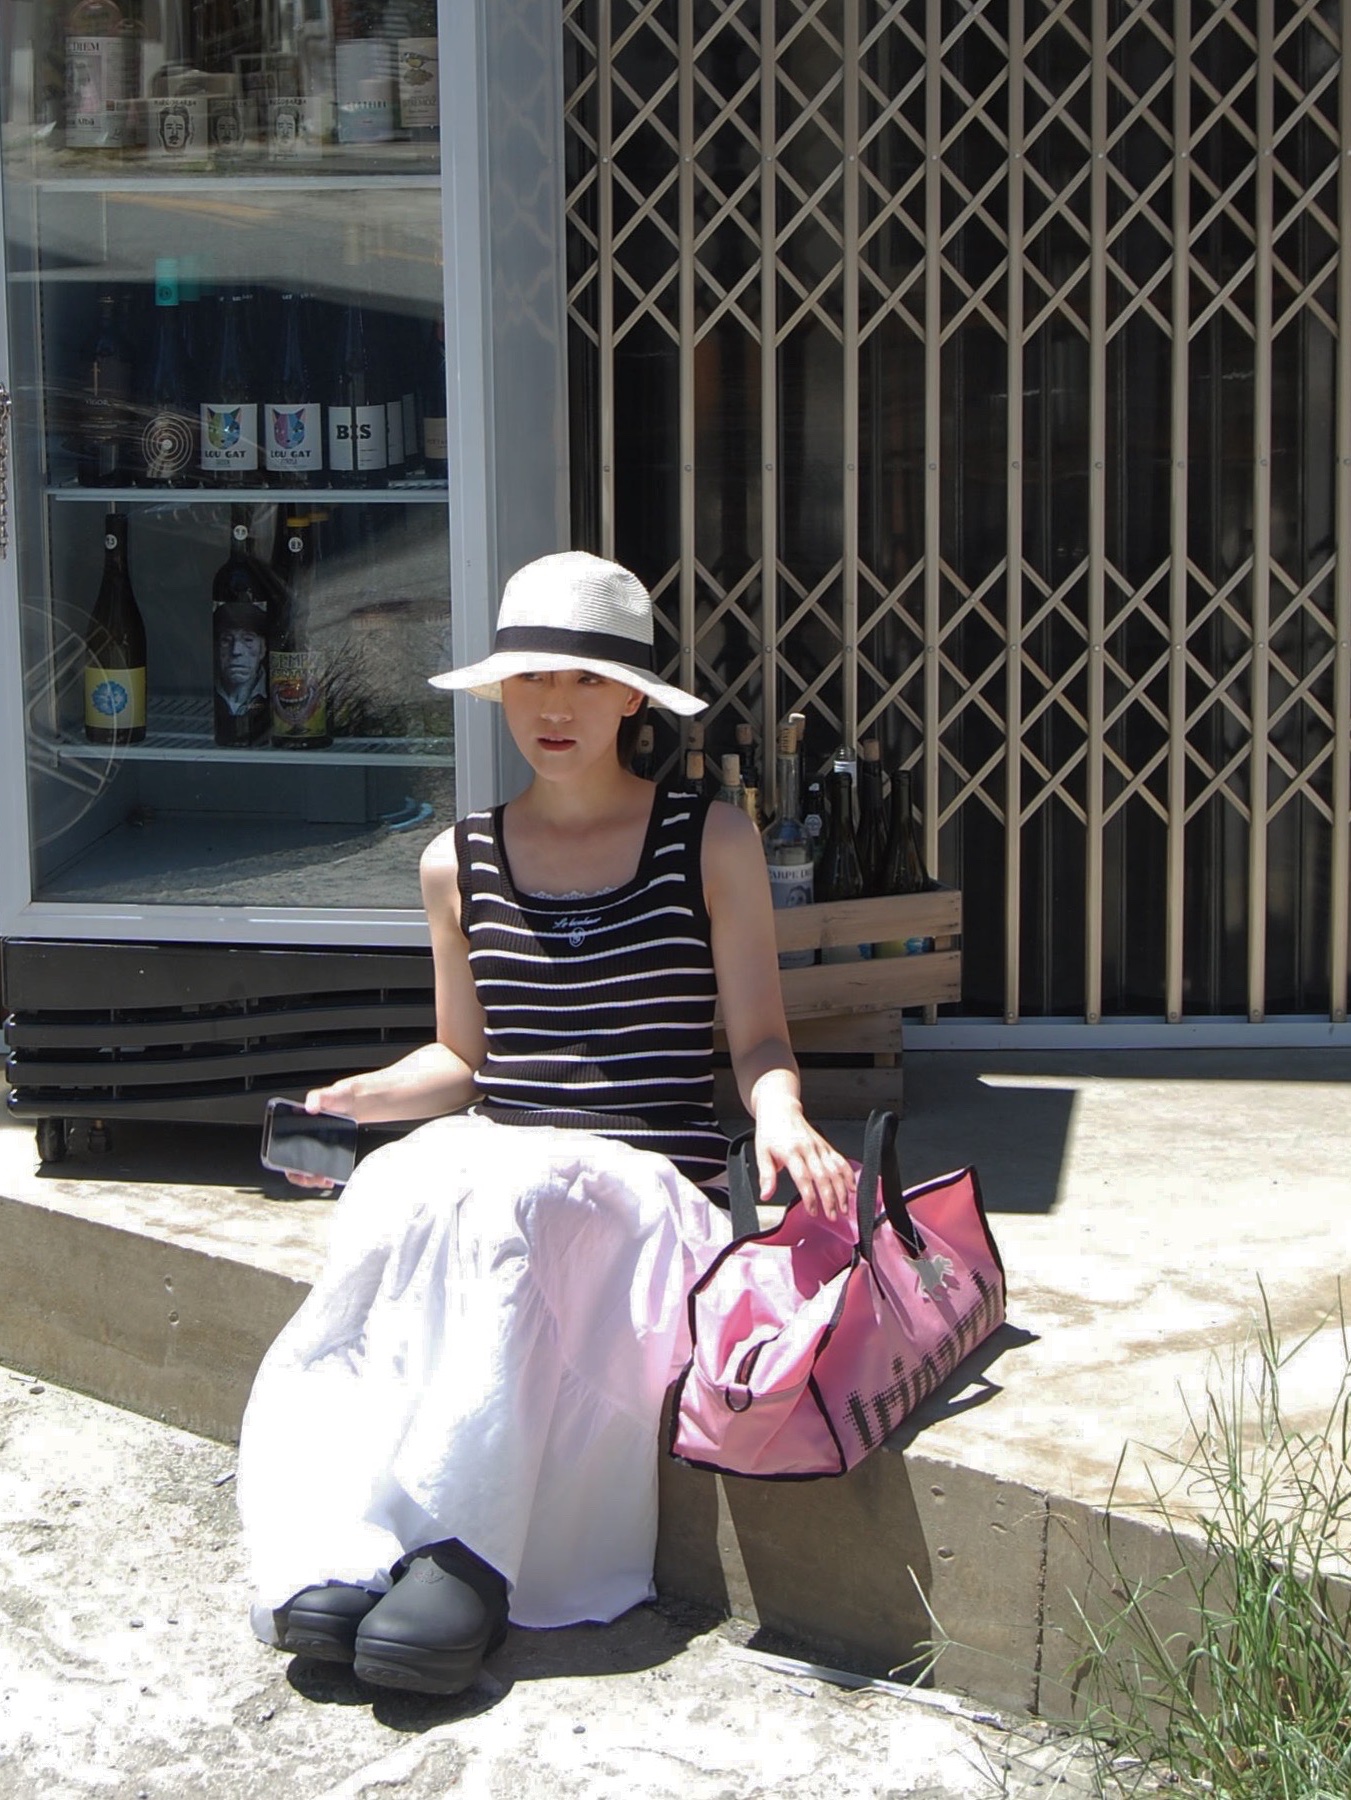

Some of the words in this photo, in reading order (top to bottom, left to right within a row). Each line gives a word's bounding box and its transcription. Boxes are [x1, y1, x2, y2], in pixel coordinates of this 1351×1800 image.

[336, 424, 372, 440] BIS
[204, 450, 221, 458] LOU
[224, 450, 247, 458] GAT
[270, 450, 287, 458] LOU
[290, 450, 312, 458] GAT
